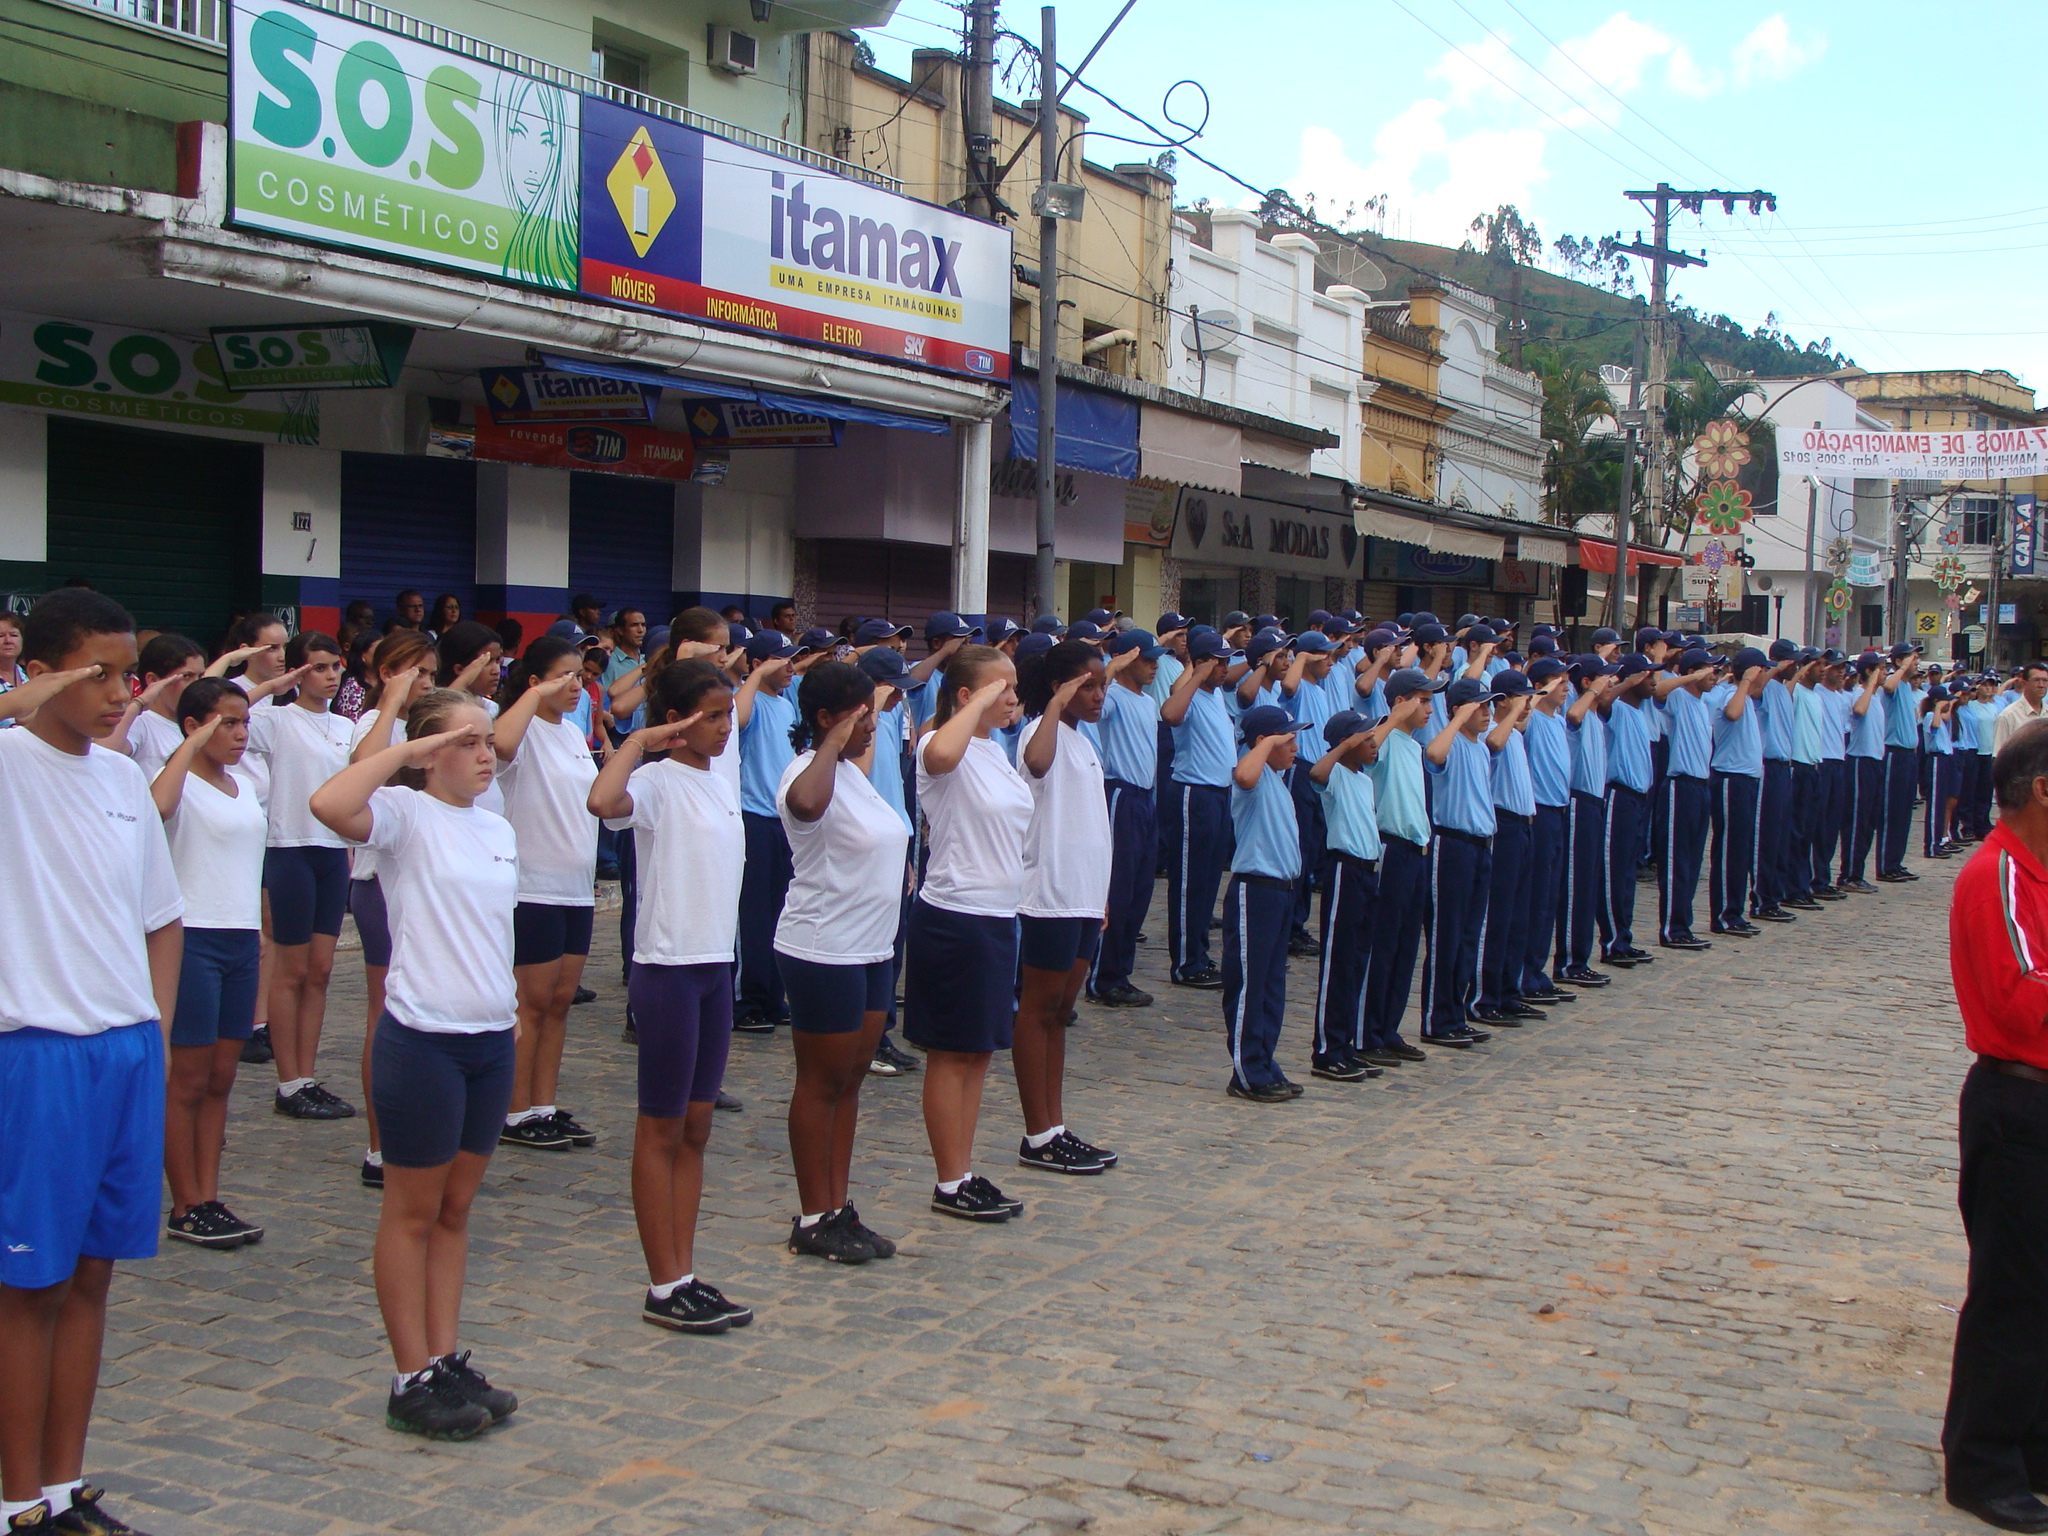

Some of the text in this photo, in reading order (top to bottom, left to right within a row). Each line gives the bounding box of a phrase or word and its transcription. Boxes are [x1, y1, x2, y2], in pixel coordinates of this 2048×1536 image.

[250, 10, 485, 190] S.O.S
[258, 171, 500, 251] COSMÉTICOS
[770, 170, 963, 298] itamax
[778, 272, 958, 319] UMA EMPRESA ITAMÁQUINAS
[611, 274, 992, 370] MÓVEIS INFORMÁTICA ELETRO SKY TIM
[225, 331, 331, 370] S.O.S
[238, 369, 343, 384] COSMÉTICOS
[532, 372, 640, 399] itamax
[37, 391, 245, 426] COSMÉTICOS
[510, 428, 685, 463] revenda TIM ITAMAX
[1269, 518, 1330, 560] MODAS
[2014, 503, 2032, 567] CAIXA
